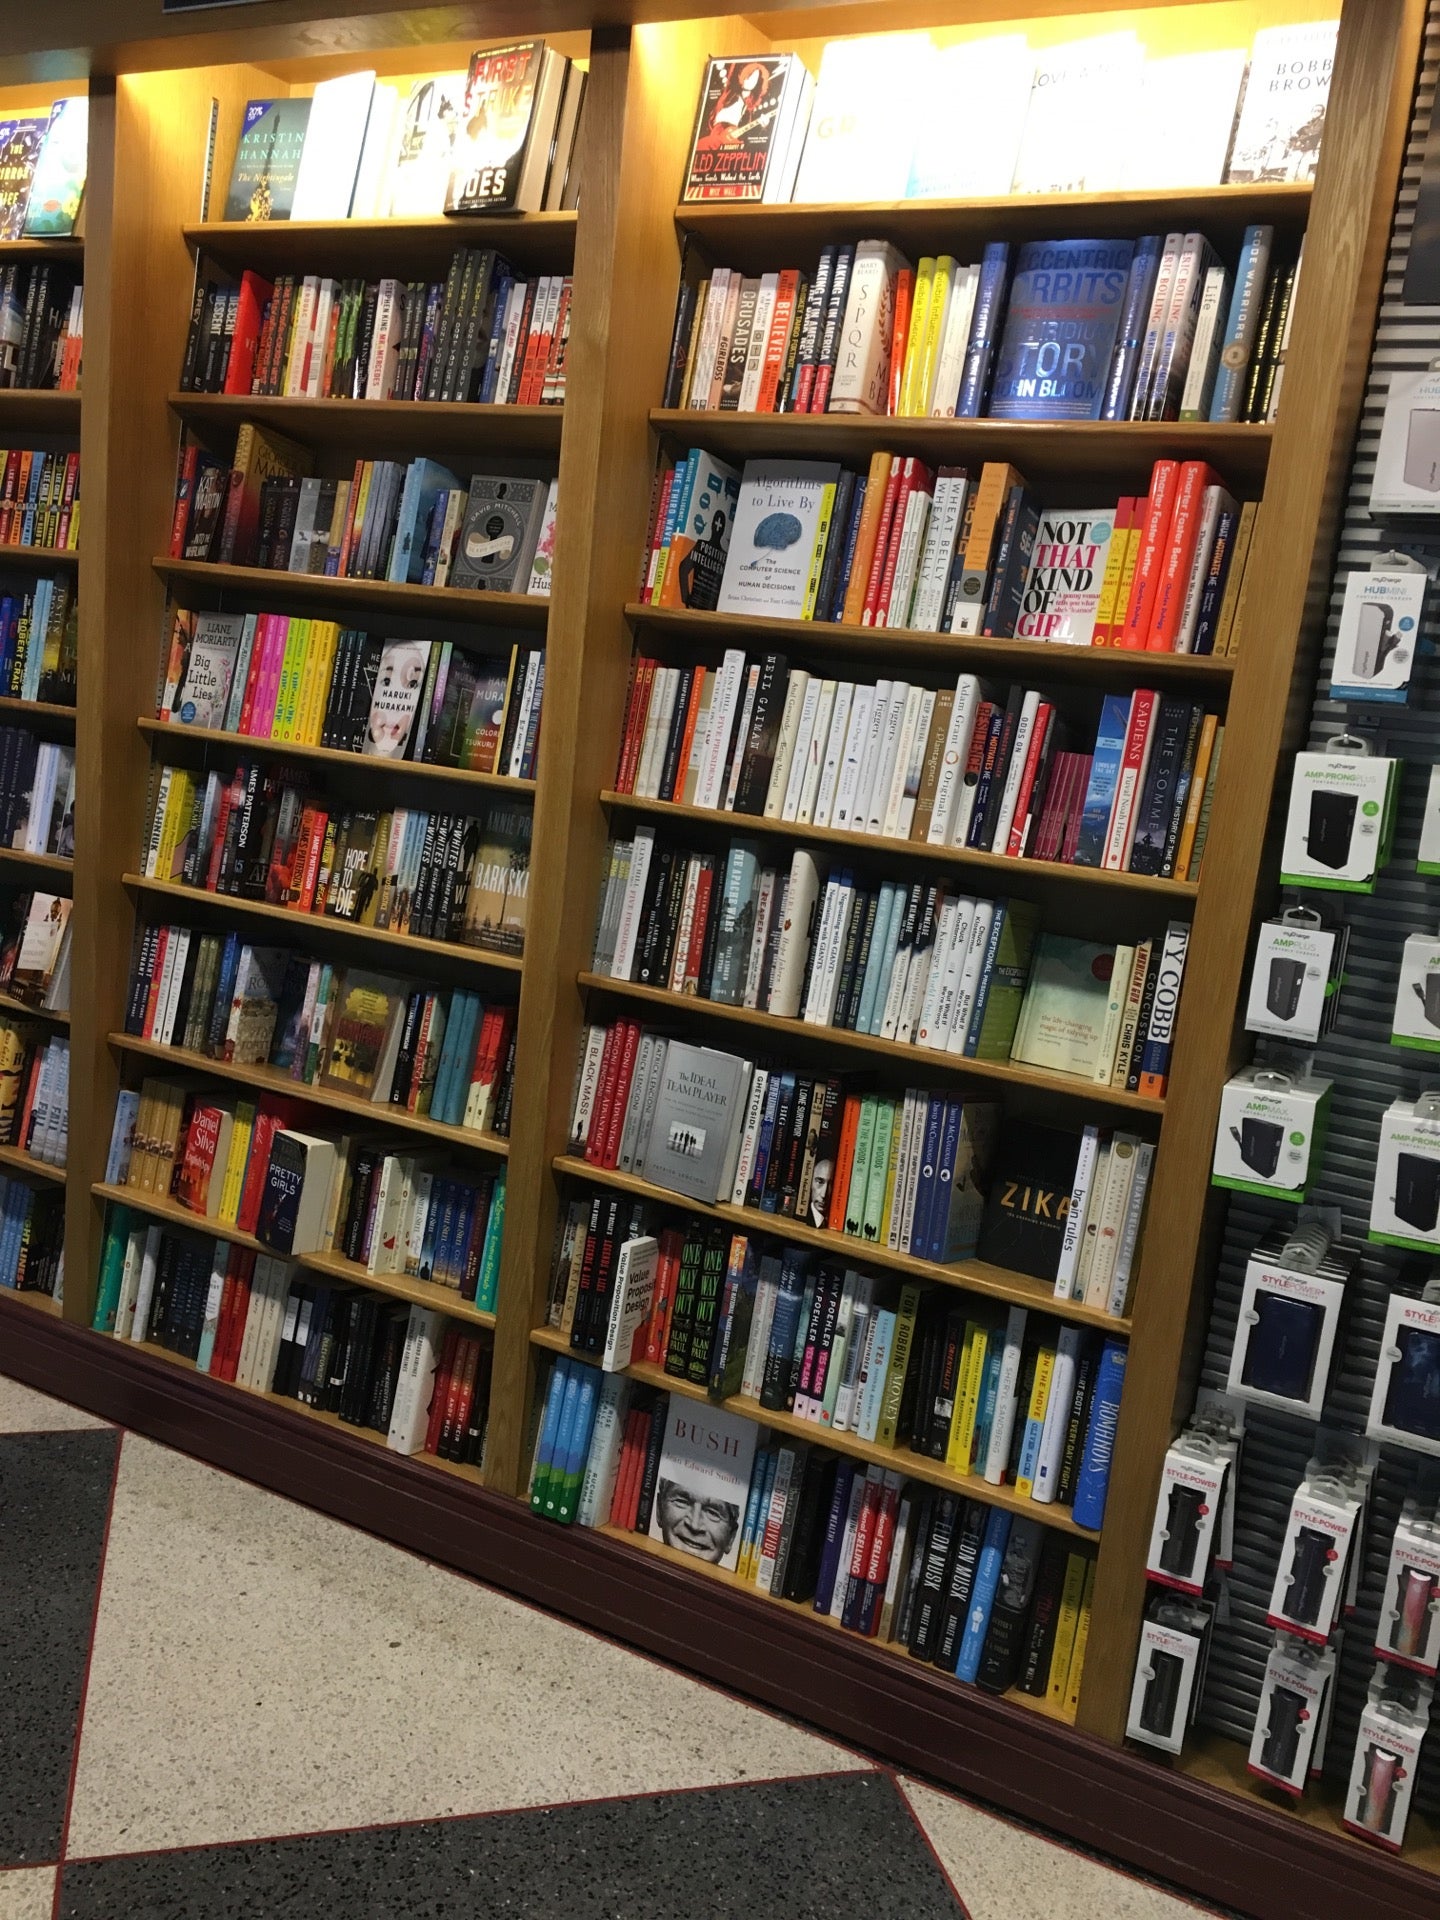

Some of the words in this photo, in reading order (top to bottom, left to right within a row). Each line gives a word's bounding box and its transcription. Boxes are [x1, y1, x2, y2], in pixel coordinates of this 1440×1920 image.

[243, 132, 305, 144] KRISTIN
[240, 148, 301, 160] HANNAH
[693, 152, 713, 173] LED
[714, 151, 767, 172] ZEPPELIN
[1162, 251, 1175, 272] ERIC
[1181, 251, 1192, 272] ERIC
[1249, 230, 1263, 263] CODE
[831, 255, 849, 295] MAKING
[192, 288, 204, 325] GREY
[381, 282, 394, 314] STEPHEN
[444, 280, 454, 316] KUBICA
[457, 283, 468, 318] KUBICA
[471, 283, 482, 317] KUBICA
[1152, 277, 1170, 323] BOLLING
[1169, 277, 1186, 323] BOLLING
[1203, 285, 1218, 311] Life
[1235, 270, 1256, 340] WARRIORS
[210, 296, 227, 336] DESCENT
[379, 315, 388, 331] KING
[731, 291, 756, 363] CRUSADES
[768, 302, 791, 362] BELIEVER
[820, 319, 836, 361] AMERICA
[714, 336, 728, 381] #GIRLBOSS
[753, 476, 822, 490] Algorithms
[1154, 466, 1170, 508] Smarter
[1181, 467, 1198, 510] Smarter
[195, 493, 222, 511] MARTIN
[471, 505, 491, 522] DAVID
[494, 503, 522, 526] MITCHELL
[669, 488, 680, 516] THIRD
[751, 496, 763, 506] to
[768, 496, 795, 508] Live
[799, 496, 815, 513] By
[930, 483, 948, 532] WHEAT
[943, 483, 961, 532] WHEAT
[663, 518, 674, 542] WAVE
[876, 483, 894, 559] CUSTOMER-CENTRIC
[888, 484, 908, 559] CUSTOMER-CENTRIC
[1041, 521, 1092, 545] NOT
[1149, 511, 1162, 543] Faster
[1175, 512, 1189, 544] Faster
[700, 541, 727, 563] POSITIVE
[920, 539, 936, 581] BELLY
[935, 540, 950, 582] BELLY
[1036, 545, 1101, 569] THAT
[1142, 546, 1155, 577] Better
[1168, 547, 1182, 578] Better
[739, 565, 773, 573] COMPUTER
[774, 567, 801, 575] SCIENCE
[868, 560, 881, 602] MARKETING
[881, 561, 893, 603] MARKETING
[1028, 568, 1093, 592] KIND
[762, 583, 795, 591] DECISIONS
[1024, 591, 1055, 614] OF
[17, 618, 28, 660] ROBERT
[207, 623, 232, 634] LIANE
[1017, 612, 1075, 638] GIRL
[196, 635, 238, 647] MORIARTY
[11, 660, 22, 691] CRAIS
[194, 654, 211, 670] Big
[762, 655, 776, 690] NEIL
[188, 670, 217, 686] Little
[192, 687, 213, 701] Lies
[374, 701, 415, 712] MURAKAMI
[382, 689, 412, 700] HARUKI
[802, 695, 818, 722] blink
[958, 681, 971, 712] Adam
[751, 697, 768, 750] GAIMAN
[871, 698, 888, 739] Triggers
[888, 700, 905, 741] Triggers
[951, 714, 965, 745] Grant
[1130, 701, 1149, 761] SAPIENS
[466, 739, 495, 749] TSUKURU
[966, 702, 993, 772] RESILIENCE
[1162, 727, 1178, 757] THE
[706, 737, 721, 793] PRESIDENTS
[984, 736, 1000, 771] MOTIVATES
[248, 764, 259, 793] JAMES
[936, 770, 954, 817] Originals
[1124, 775, 1133, 800] Yuval
[1148, 768, 1170, 830] SOMME
[150, 785, 169, 852] PALAHNIUK
[239, 794, 253, 848] PATTERSON
[1172, 806, 1182, 834] HISTORY
[422, 825, 435, 864] WHITES
[434, 826, 448, 866] WHITES
[448, 829, 463, 868] WHITES
[1113, 821, 1124, 848] Harari
[305, 852, 318, 890] PATTERSON
[346, 848, 369, 871] HOPE
[342, 868, 353, 887] TO
[335, 887, 356, 916] DIE
[756, 892, 769, 933] REAPER
[138, 937, 151, 977] REVENANT
[146, 938, 160, 978] REVENANT
[1164, 930, 1190, 965] TY
[1134, 947, 1149, 988] AMERICAN
[1134, 972, 1157, 1063] CONCUSSION
[1151, 970, 1180, 1039] COBB
[623, 1025, 636, 1070] LENCIONI
[1121, 1023, 1133, 1050] CHRIS
[583, 1047, 599, 1083] BLACK
[1116, 1051, 1129, 1075] KYLE
[666, 1079, 692, 1096] TEAM
[693, 1085, 728, 1106] PLAYER
[691, 1072, 717, 1090] IDEAL
[580, 1085, 592, 1116] MASS
[749, 1076, 764, 1130] GHETTOSIDE
[193, 1110, 220, 1135] Daniel
[608, 1099, 622, 1150] ADVANTAGE
[195, 1128, 215, 1155] Silva
[269, 1163, 302, 1185] PRETTY
[270, 1177, 296, 1195] GIRLS
[1000, 1181, 1072, 1221] ZIKA
[1064, 1221, 1078, 1252] rules
[617, 1252, 628, 1275] Value
[682, 1243, 703, 1265] ONE
[704, 1249, 724, 1272] ONE
[629, 1269, 650, 1285] Value
[679, 1269, 699, 1290] WAY
[701, 1275, 720, 1297] WAY
[612, 1276, 624, 1321] Proposition
[625, 1297, 650, 1315] Design
[675, 1294, 694, 1316] OUT
[696, 1301, 716, 1322] OUT
[904, 1294, 916, 1323] TONY
[808, 1295, 823, 1342] POEHLER
[822, 1300, 836, 1347] POEHLER
[607, 1322, 617, 1351] Design
[692, 1336, 710, 1349] ALAN
[893, 1323, 910, 1370] ROBBINS
[885, 1374, 904, 1423] MONEY
[675, 1417, 742, 1458] BUSH
[684, 1459, 714, 1477] Edward
[715, 1470, 742, 1486] Smith
[1166, 1468, 1217, 1489] STYLE-POWER
[930, 1521, 950, 1552] ELON
[1294, 1510, 1347, 1534] STYLE-POWER
[851, 1534, 871, 1575] SELLING
[867, 1537, 887, 1581] SELLING
[957, 1530, 980, 1567] ELON
[923, 1553, 946, 1592] MUSK
[949, 1567, 973, 1602] MUSK
